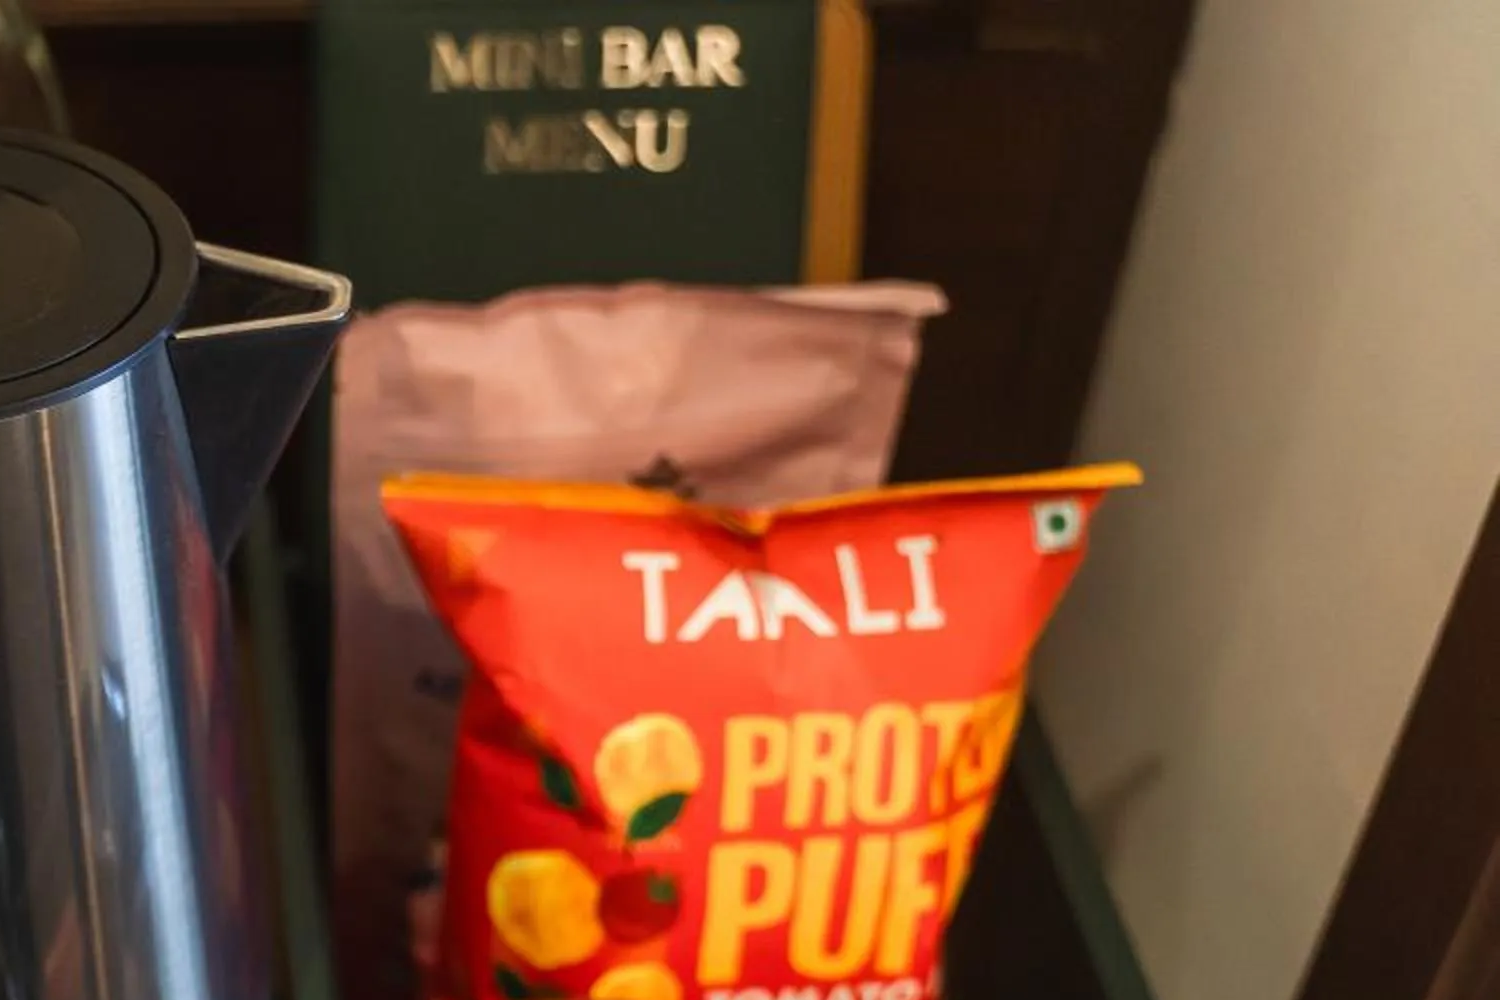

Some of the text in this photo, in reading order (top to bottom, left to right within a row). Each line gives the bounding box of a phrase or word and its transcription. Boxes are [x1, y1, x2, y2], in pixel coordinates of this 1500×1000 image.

[430, 24, 746, 92] MINI BAR
[482, 108, 691, 175] MENU
[621, 535, 946, 643] TAALI
